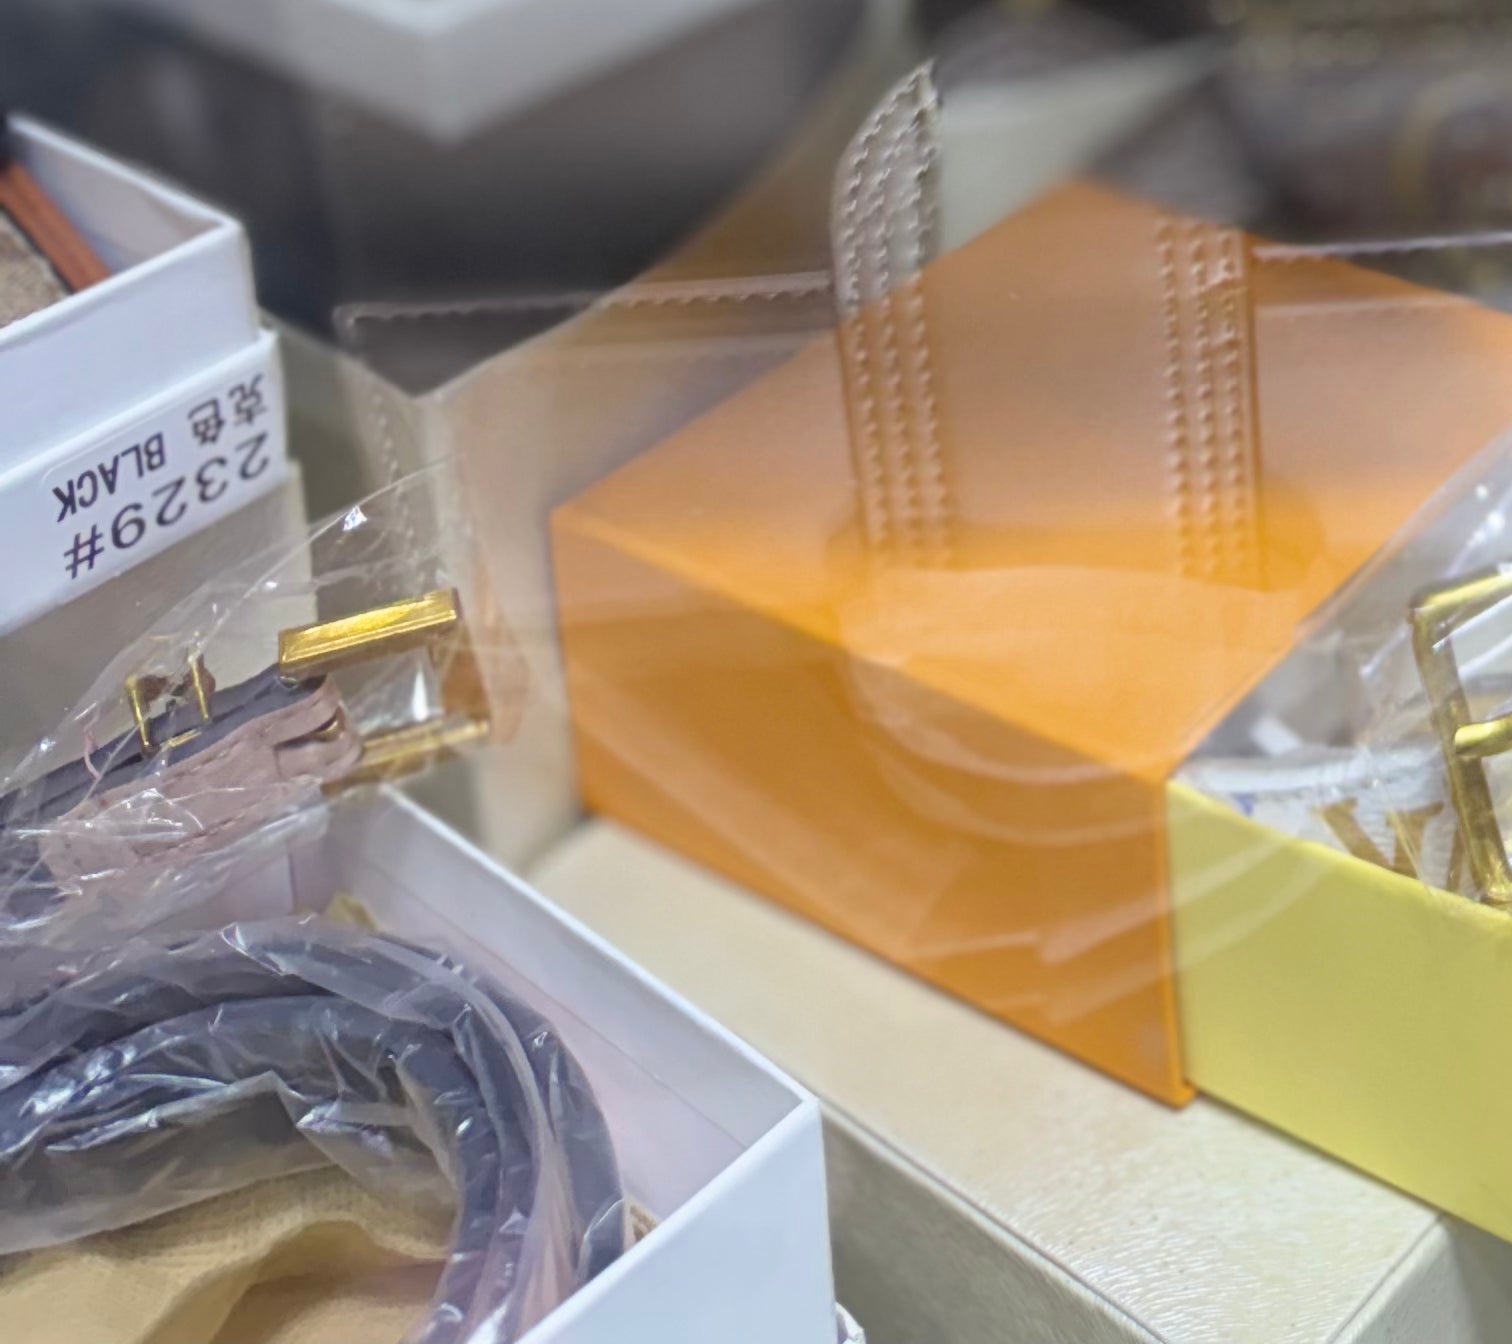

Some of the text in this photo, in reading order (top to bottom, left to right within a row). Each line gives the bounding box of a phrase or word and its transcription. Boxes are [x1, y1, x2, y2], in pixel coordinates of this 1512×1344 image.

[52, 374, 267, 523] 克色 BLACK
[63, 431, 269, 580] 2329#
